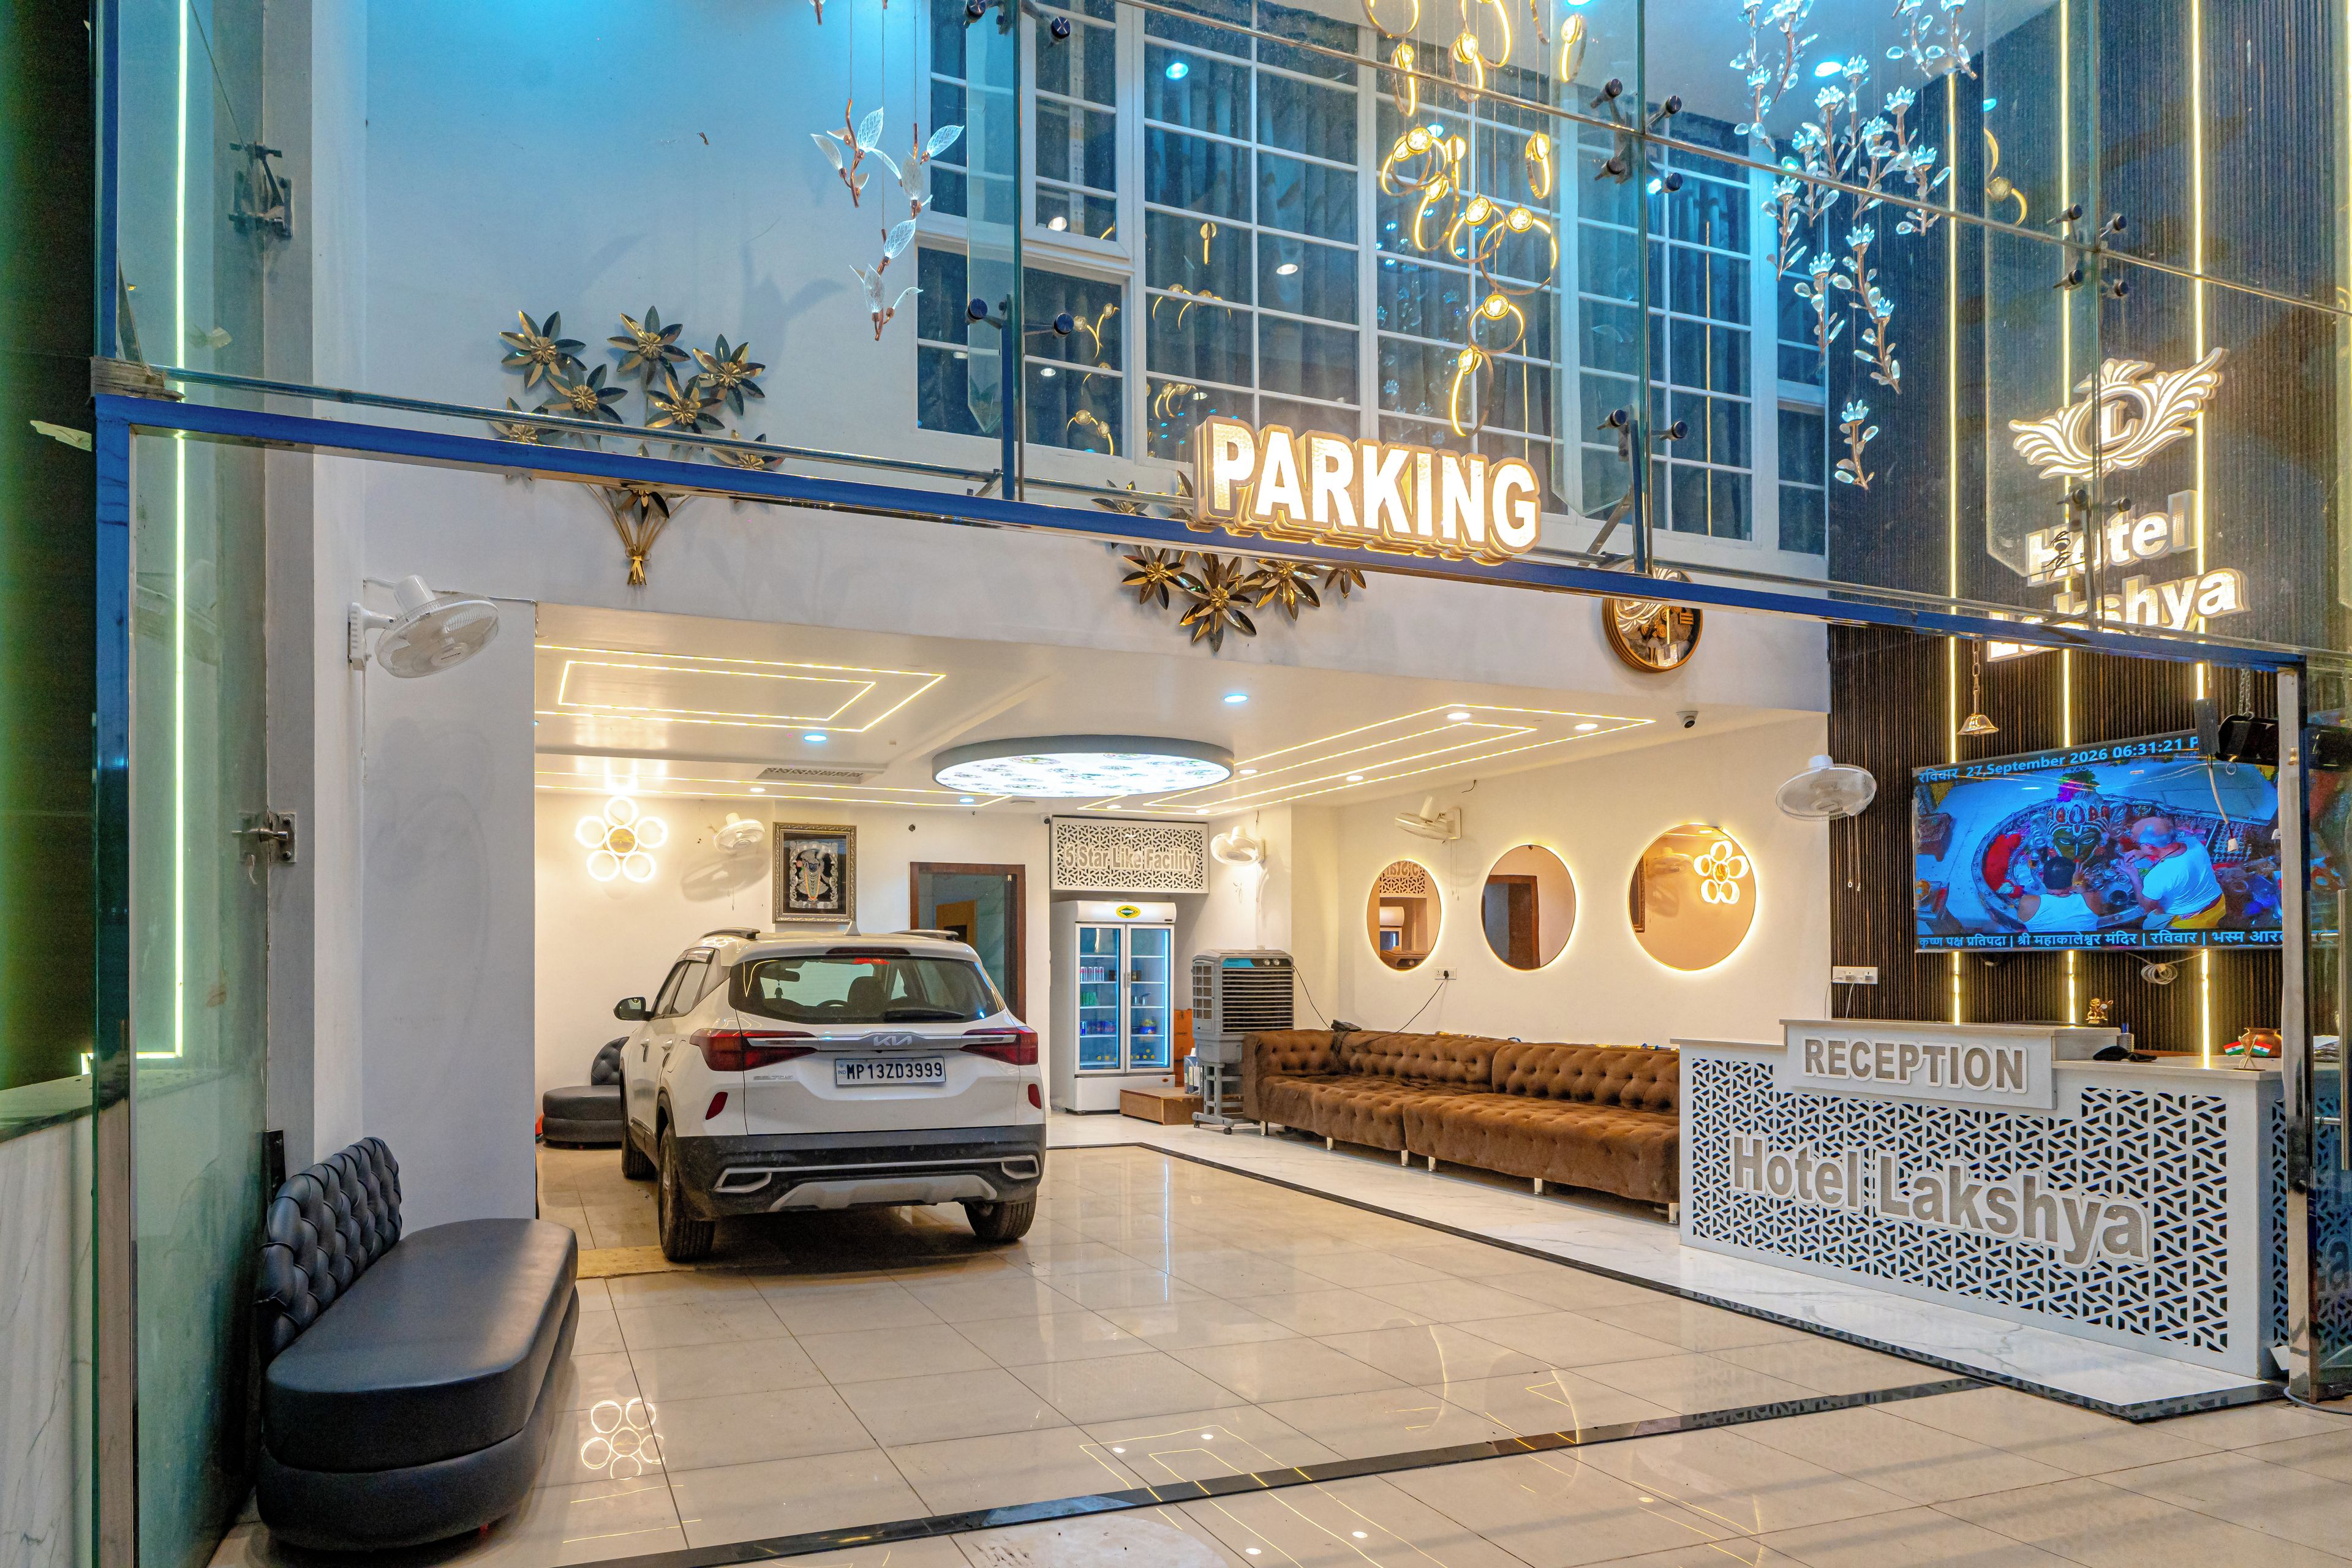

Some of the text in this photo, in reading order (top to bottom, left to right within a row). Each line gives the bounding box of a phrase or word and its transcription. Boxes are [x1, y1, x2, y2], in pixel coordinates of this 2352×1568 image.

[1207, 419, 1540, 551] PARKING
[2026, 490, 2196, 587] Hotel
[1918, 768, 1959, 783] रविवार
[2070, 748, 2108, 764] 2026
[2113, 738, 2182, 758] 06:31:21
[1065, 845, 1196, 875] 5 Star Like Facility
[2018, 932, 2032, 946] श्री
[2105, 930, 2137, 945] मंदिर
[2150, 930, 2198, 944] रविवार
[2212, 931, 2245, 943] भस्म
[846, 1062, 943, 1080] MP13ZD3999
[1804, 1038, 2026, 1091] RECEPTION
[1732, 1134, 2146, 1267] Hotel Lakshya
